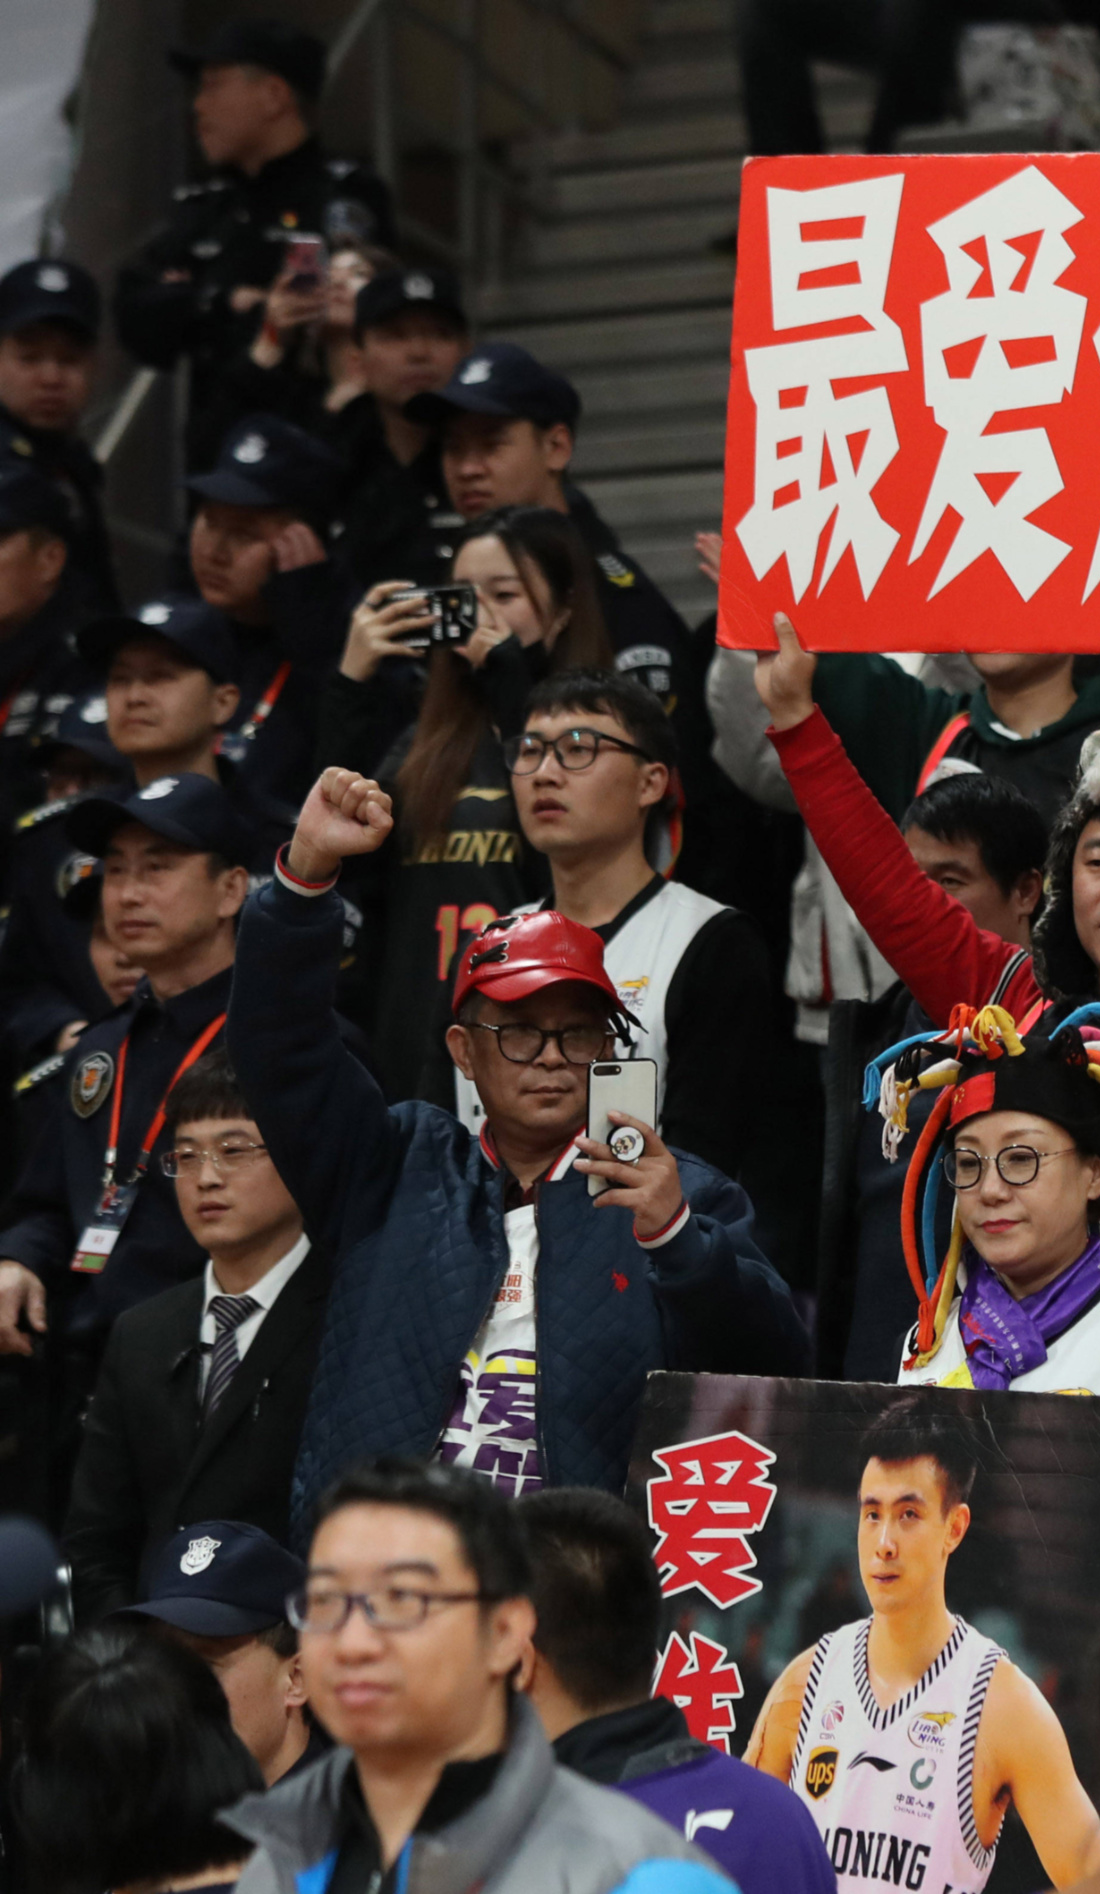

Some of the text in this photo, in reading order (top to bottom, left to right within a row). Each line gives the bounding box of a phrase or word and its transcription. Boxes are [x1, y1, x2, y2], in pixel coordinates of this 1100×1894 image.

[807, 1762, 836, 1793] ups
[893, 1805, 933, 1821] CHINA LIFE
[895, 1793, 936, 1812] 中国人寿
[824, 1826, 932, 1892] ONING
